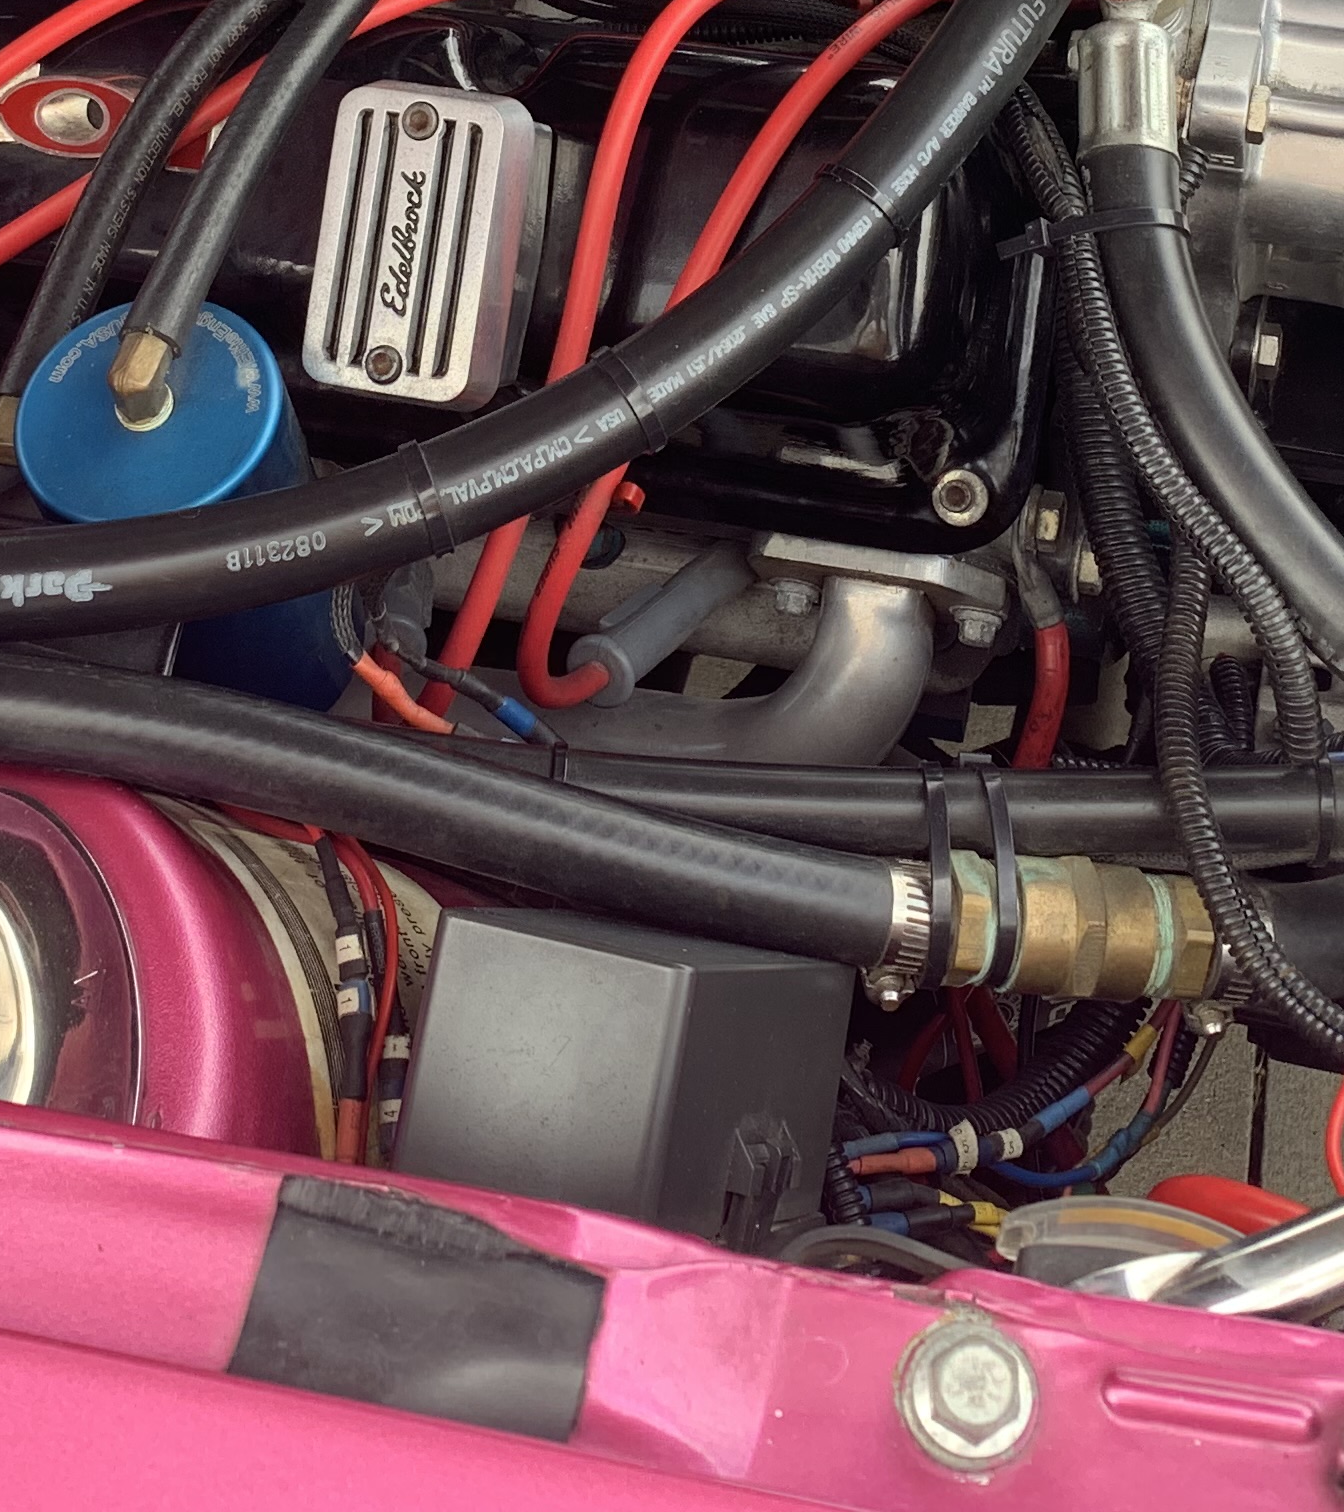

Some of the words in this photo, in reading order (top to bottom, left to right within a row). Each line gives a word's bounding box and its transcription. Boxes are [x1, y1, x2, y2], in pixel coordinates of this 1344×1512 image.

[207, 41, 227, 67] NOT
[190, 66, 209, 91] FOR
[168, 92, 193, 119] FUEL
[134, 122, 172, 186] INJECTION
[890, 165, 920, 198] HOSE
[107, 189, 138, 239] SYSTEMS
[91, 240, 113, 277] MADE
[379, 169, 427, 318] Edelbrock
[751, 302, 778, 331] SAE
[596, 407, 628, 435] USA
[224, 530, 328, 573] 082311B
